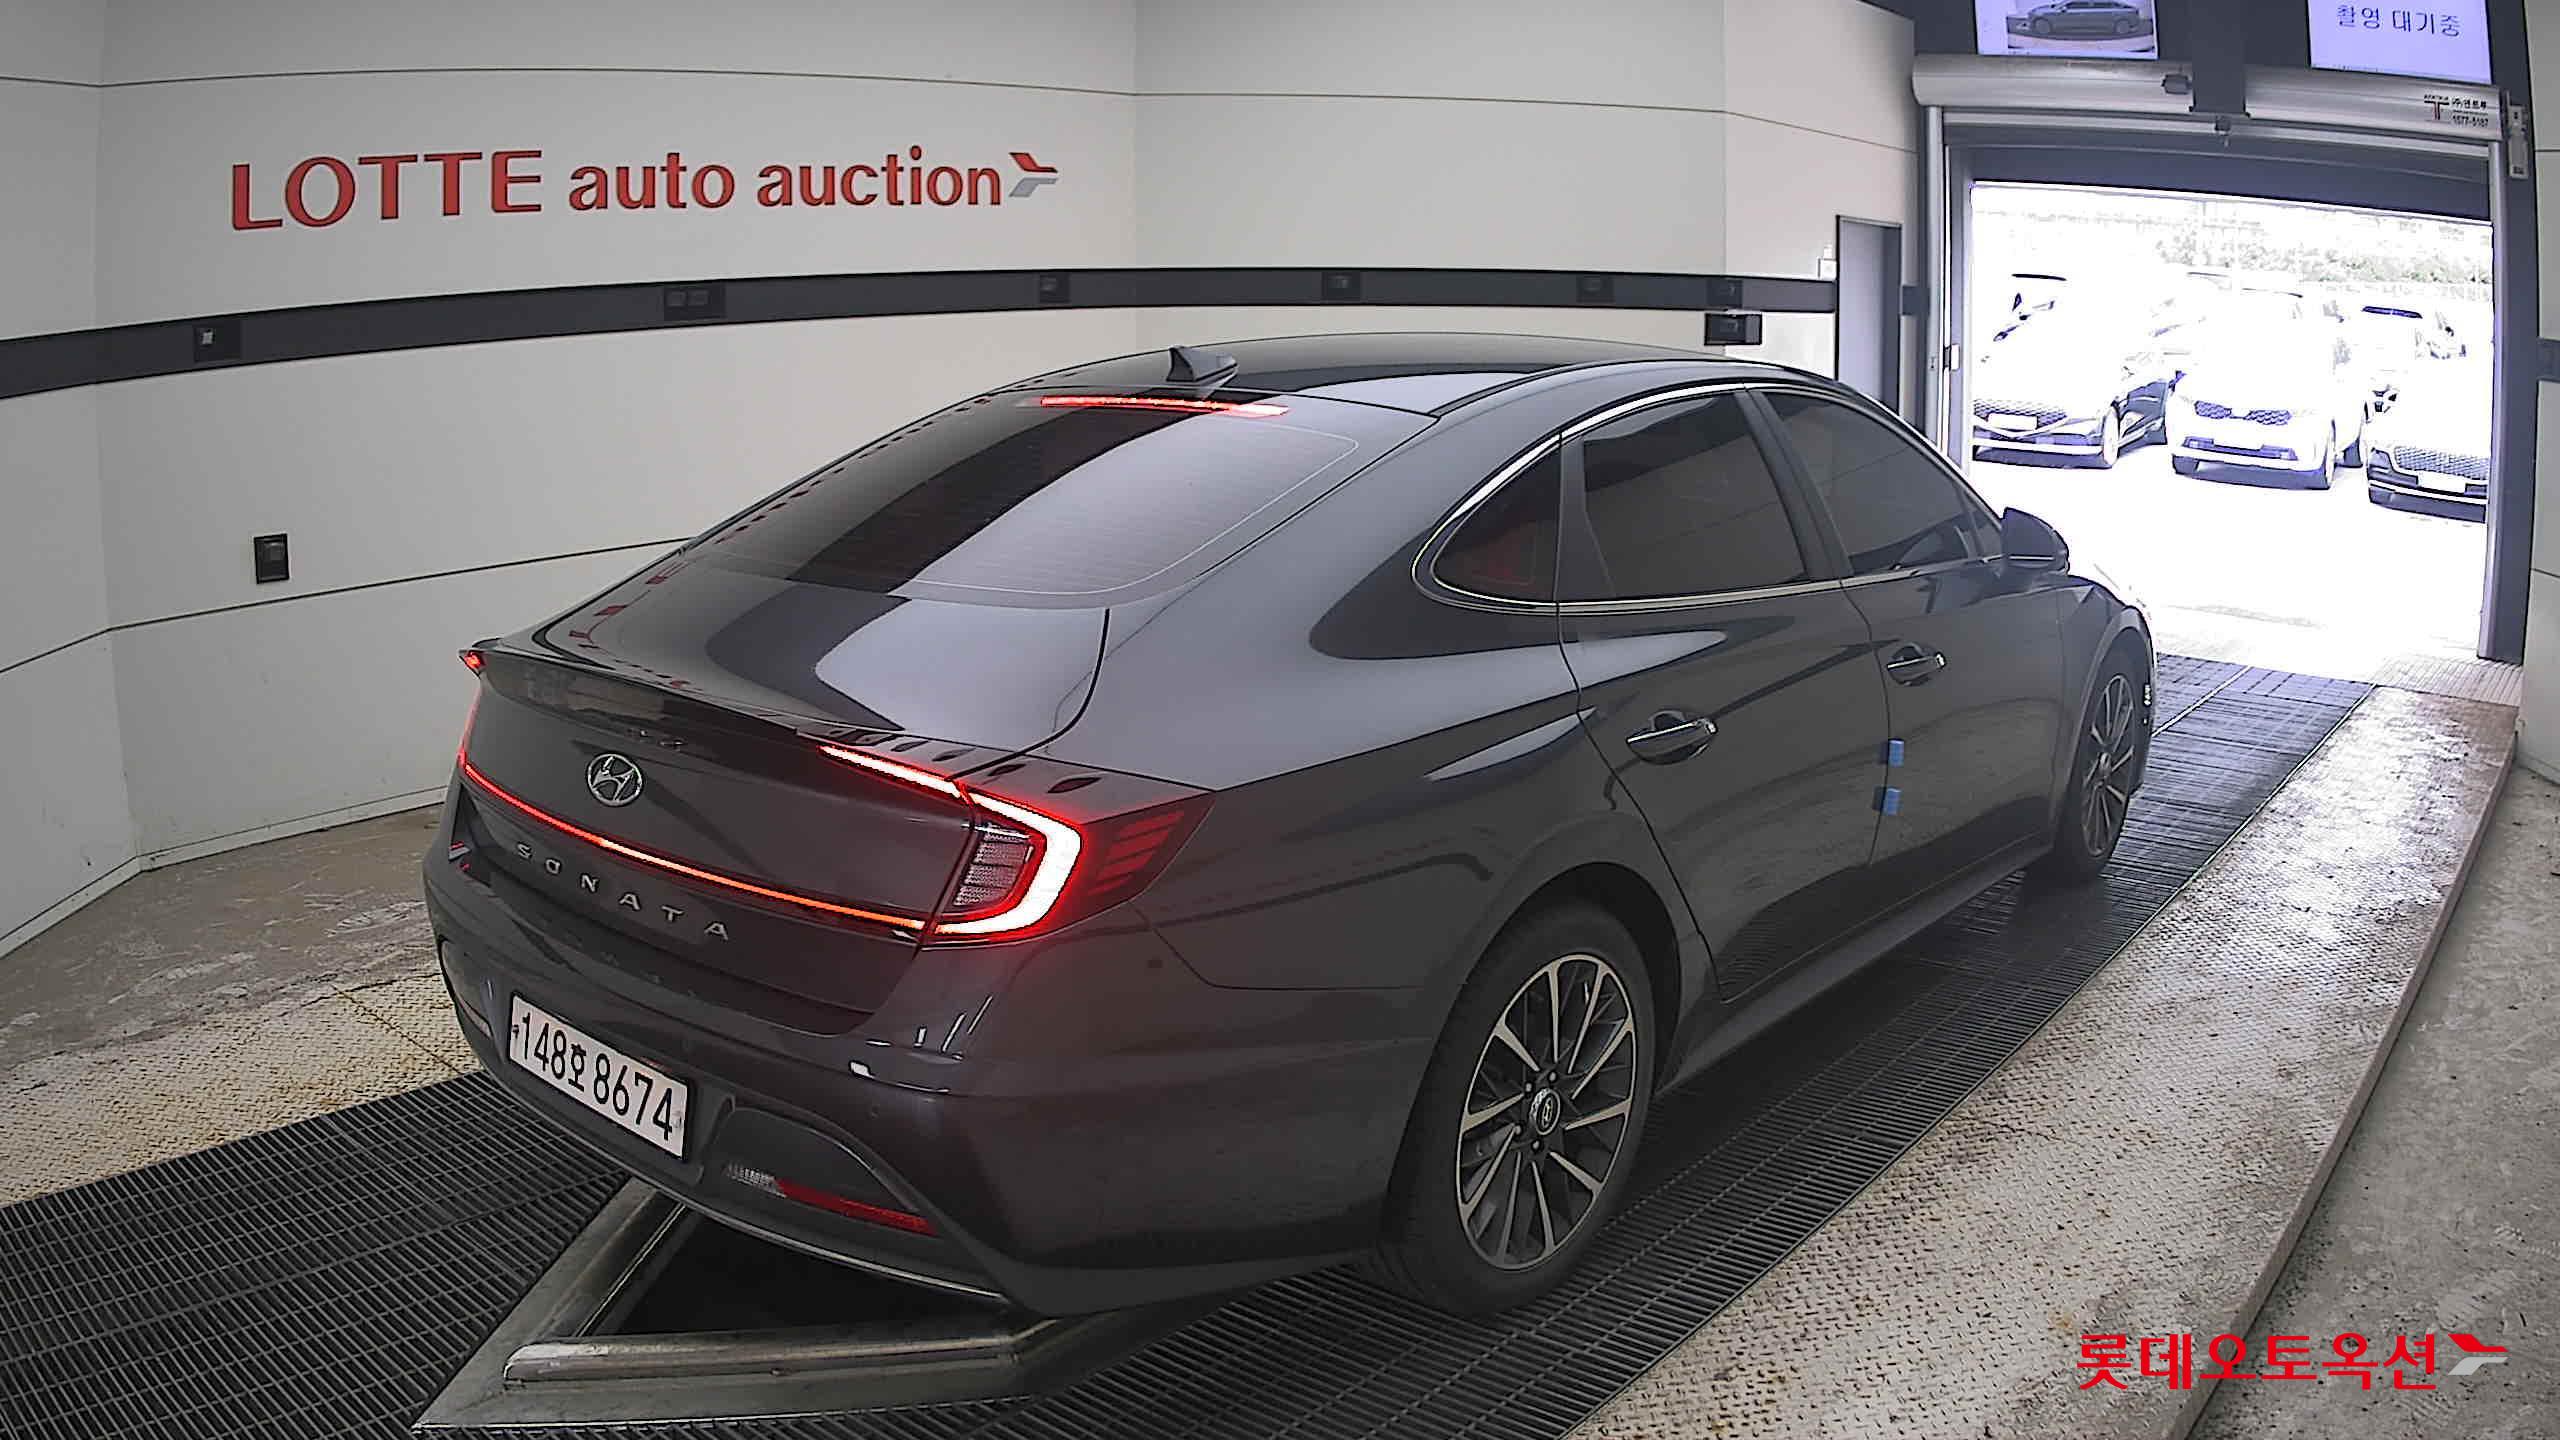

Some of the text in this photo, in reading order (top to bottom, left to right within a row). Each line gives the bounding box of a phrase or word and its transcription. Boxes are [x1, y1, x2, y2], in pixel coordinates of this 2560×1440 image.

[2338, 4, 2460, 37] 촬영 대기중
[232, 145, 1001, 230] LOTTE auto auction
[516, 842, 729, 941] SONATA
